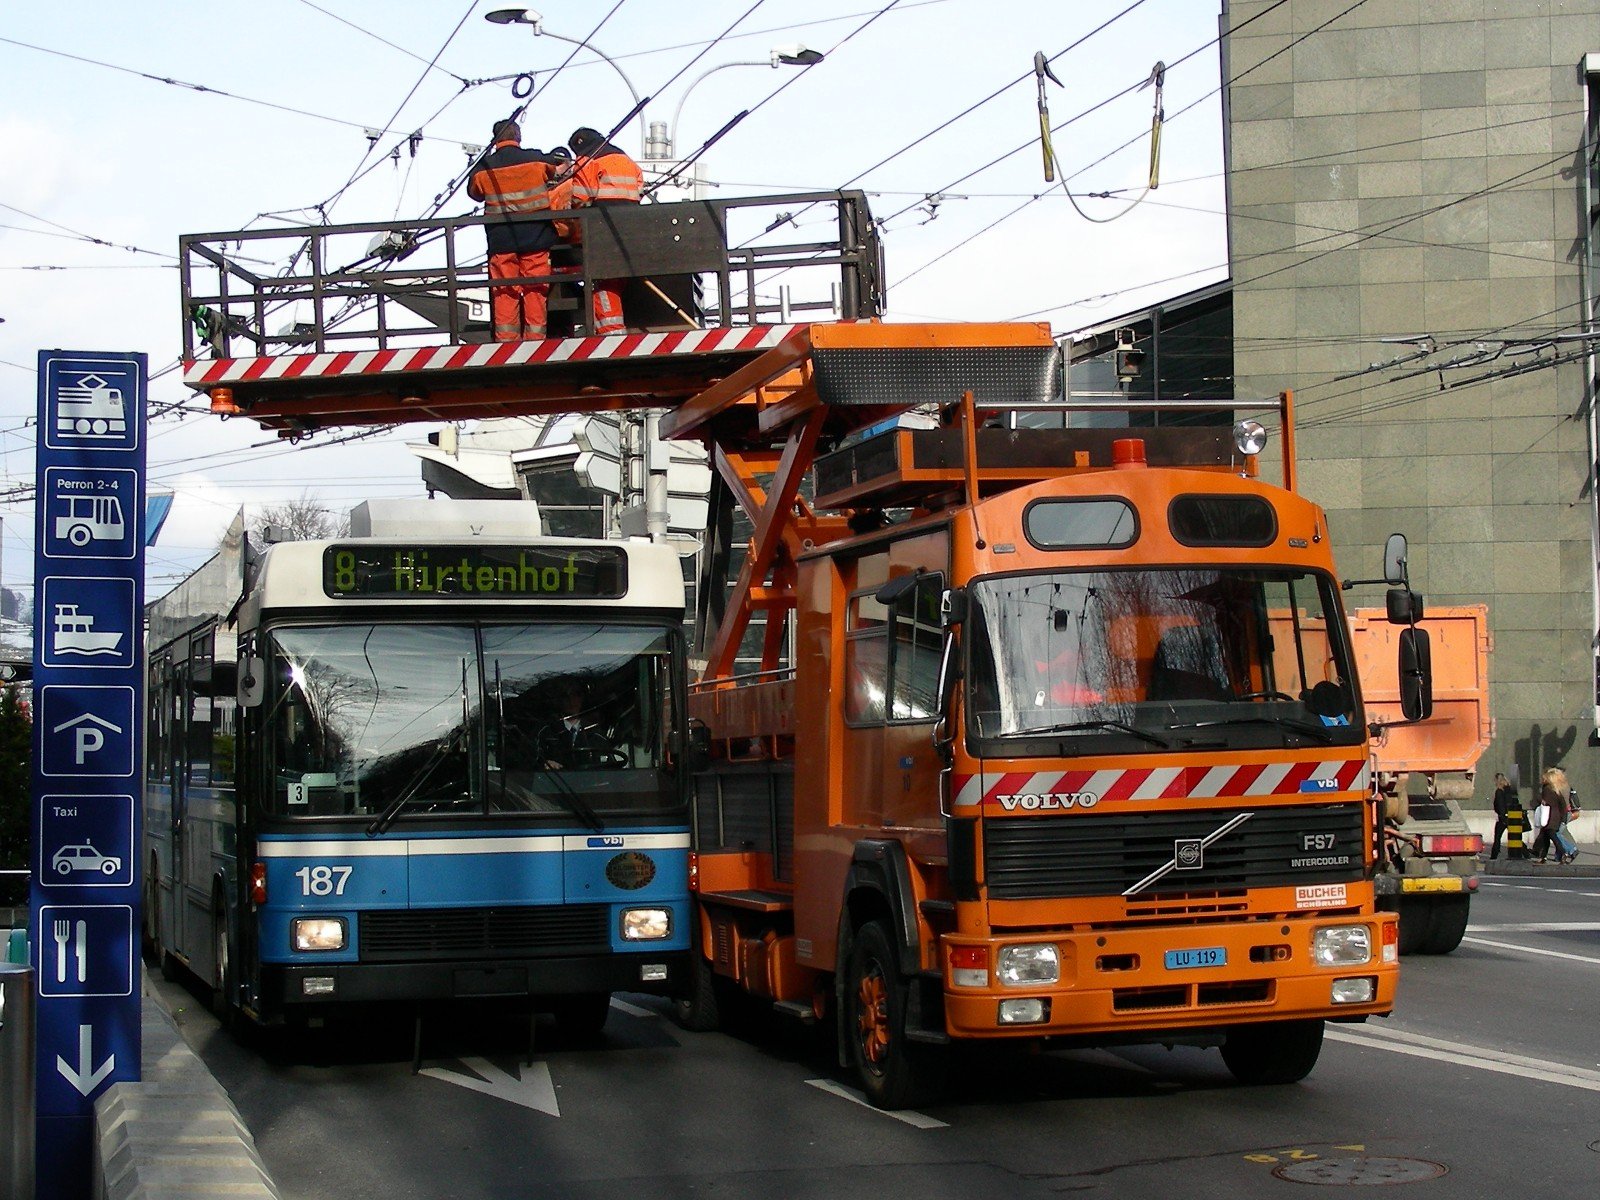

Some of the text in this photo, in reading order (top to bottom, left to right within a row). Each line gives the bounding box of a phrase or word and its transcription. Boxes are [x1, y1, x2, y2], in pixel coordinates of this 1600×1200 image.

[57, 478, 119, 490] Perron 2-4
[336, 551, 579, 591] 8 Hirtenhof
[75, 727, 104, 765] P
[1317, 777, 1338, 788] vbl
[295, 785, 303, 801] 3
[996, 792, 1099, 811] VOLVO
[53, 806, 78, 817] Taxi
[603, 836, 623, 845] vbl
[1303, 833, 1335, 850] FS7
[1291, 855, 1349, 868] INTERCOOLER
[295, 866, 353, 896] 187
[1298, 886, 1345, 899] BUCHER
[1176, 951, 1217, 966] LU 119
